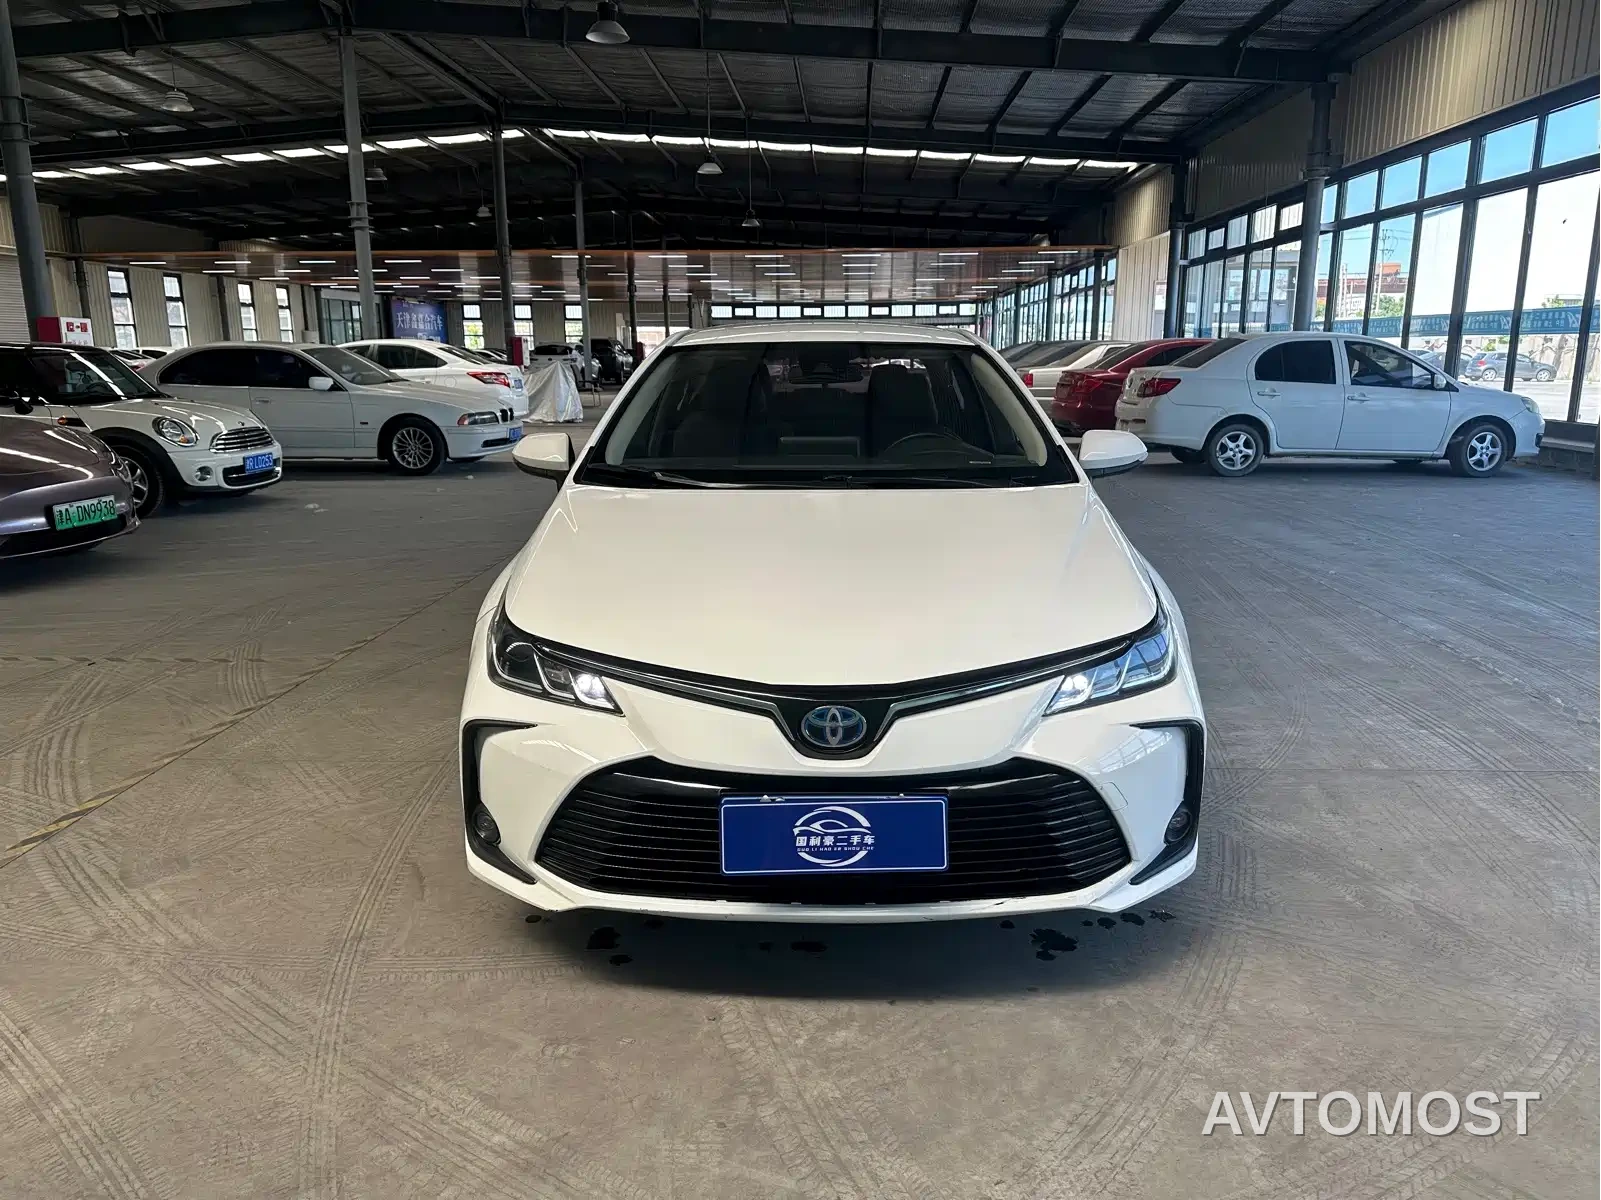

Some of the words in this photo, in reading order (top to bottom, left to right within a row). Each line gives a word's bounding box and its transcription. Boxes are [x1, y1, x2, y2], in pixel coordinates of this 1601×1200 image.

[795, 834, 876, 847] 国利豪二手车
